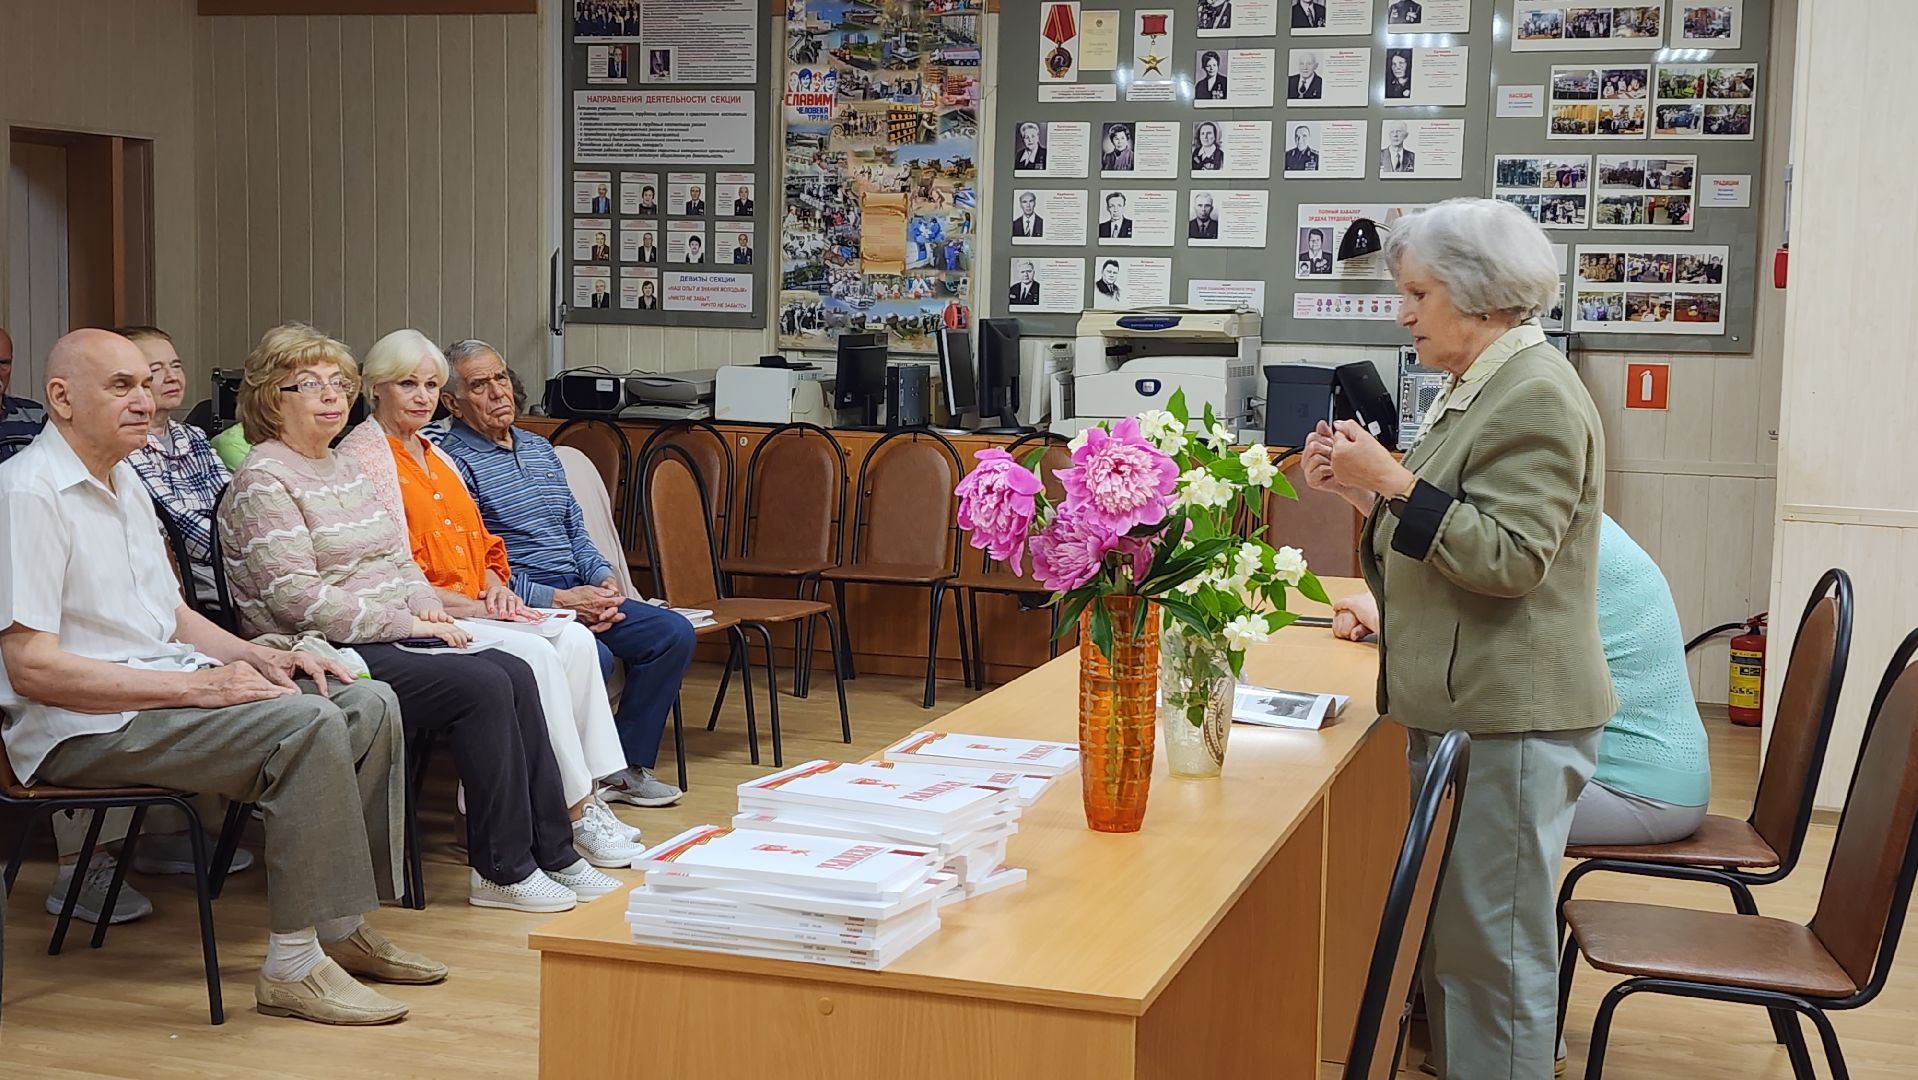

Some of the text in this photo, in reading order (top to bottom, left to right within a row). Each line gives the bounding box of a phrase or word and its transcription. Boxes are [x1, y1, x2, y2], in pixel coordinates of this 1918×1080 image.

[586, 95, 742, 104] НАПРАВЛЕНИЯ ДЕЯТЕЛЬНОСТИ СЕКЦИИ
[785, 93, 833, 107] СЛАВИМ
[796, 106, 829, 115] ЧЕЛОВЕКА
[680, 275, 736, 284] ДЕВИЗЫ СЕКЦИИ
